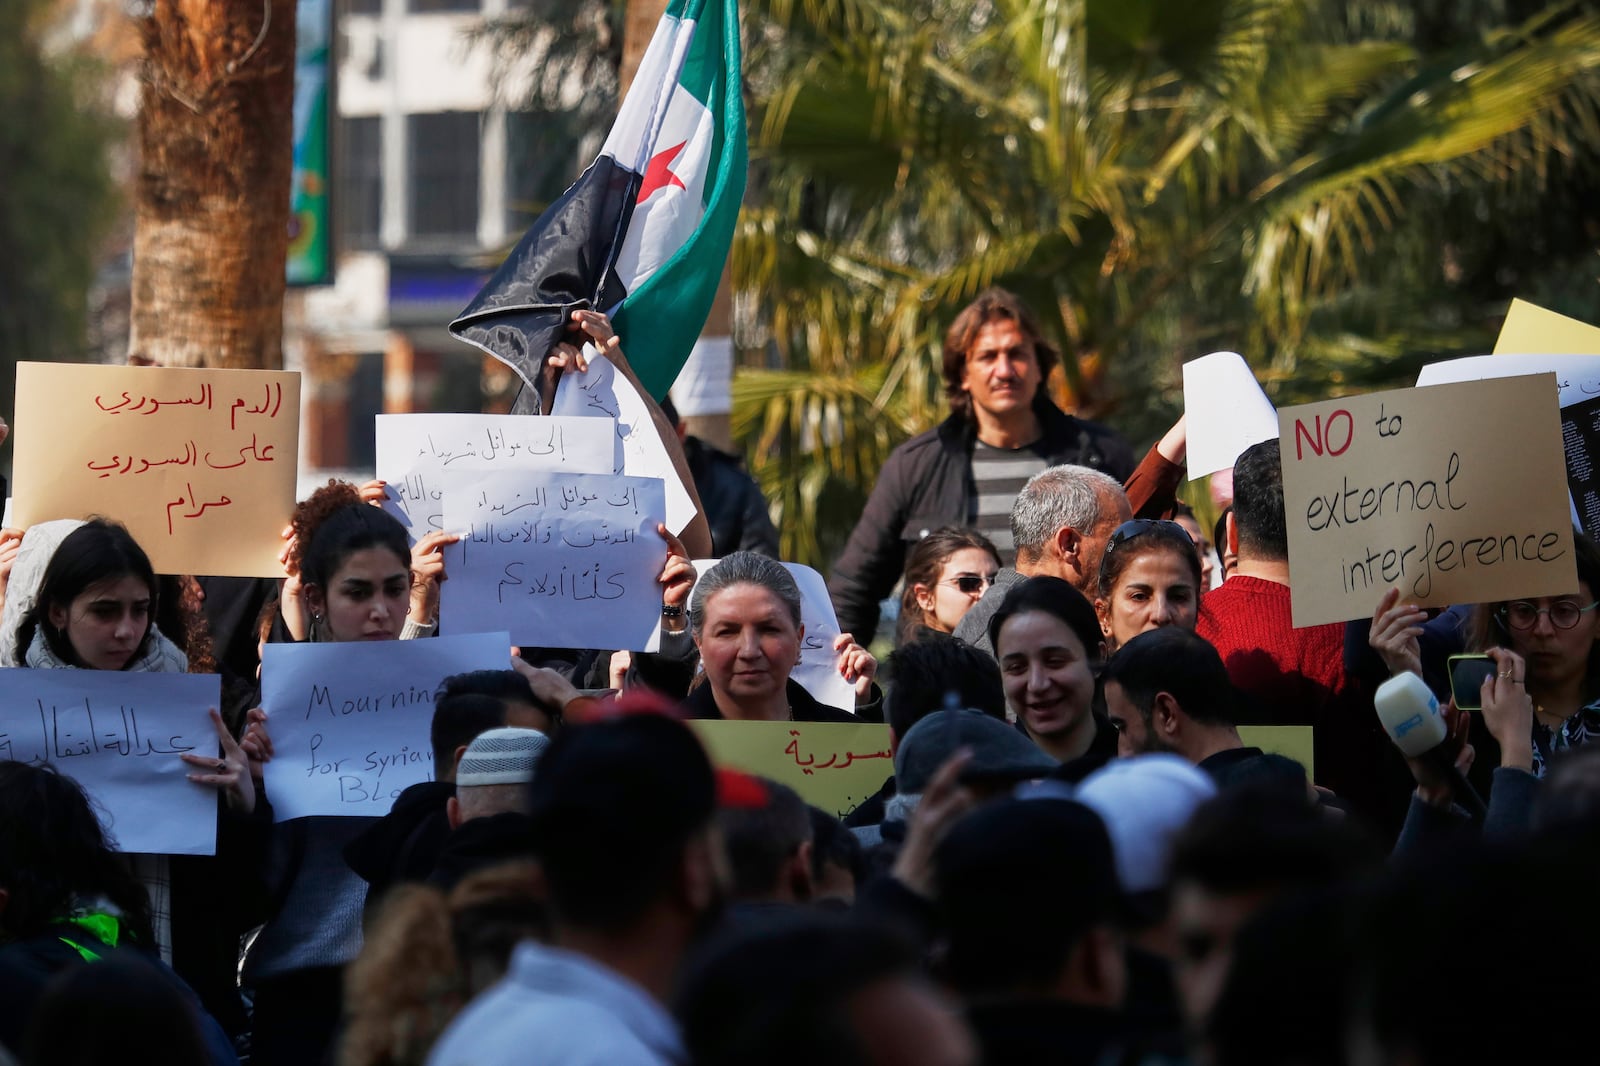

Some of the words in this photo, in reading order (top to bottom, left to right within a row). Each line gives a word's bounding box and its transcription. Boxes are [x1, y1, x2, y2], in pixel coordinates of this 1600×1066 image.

[94, 383, 213, 415] السوري
[230, 382, 282, 431] الدم
[204, 432, 275, 469] على
[417, 432, 477, 466] شهداء
[1295, 408, 1354, 461] NO
[1375, 402, 1403, 438] to
[87, 440, 197, 479] السوري
[165, 482, 232, 536] حرام
[478, 486, 548, 516] الشهداء
[1306, 451, 1468, 532] external
[498, 561, 566, 604] أولادكم
[1341, 522, 1567, 599] interference
[305, 684, 438, 721] Mournin
[103, 704, 196, 757] عدالة
[784, 729, 893, 775] سورية
[307, 733, 349, 778] for
